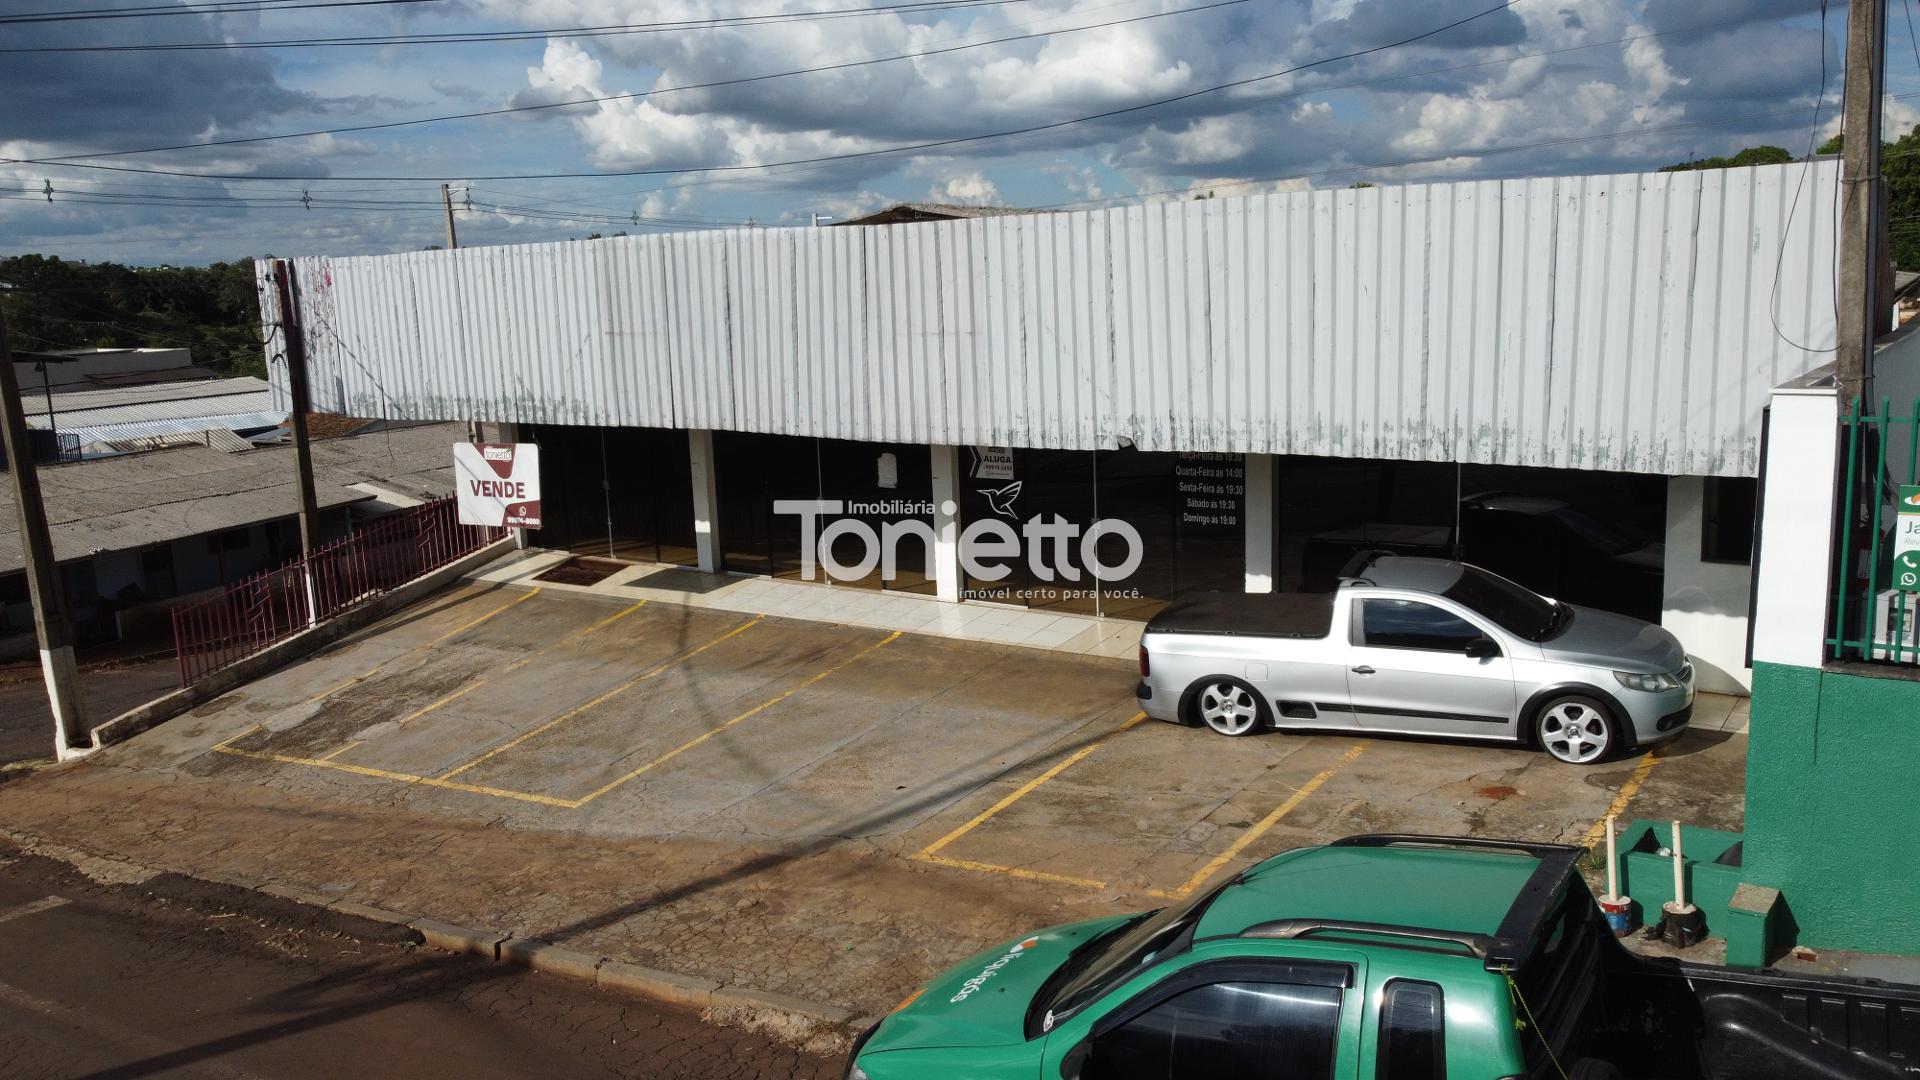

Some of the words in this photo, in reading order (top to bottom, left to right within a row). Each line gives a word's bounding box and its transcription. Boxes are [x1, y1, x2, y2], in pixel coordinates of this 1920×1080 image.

[984, 455, 1012, 464] ALUGA
[1175, 465, 1215, 477] Quarta-Feira
[470, 480, 525, 498] VENDE
[1179, 481, 1215, 494] Sexta-Feira
[1186, 498, 1210, 508] Sábado
[1183, 512, 1211, 525] Domingo
